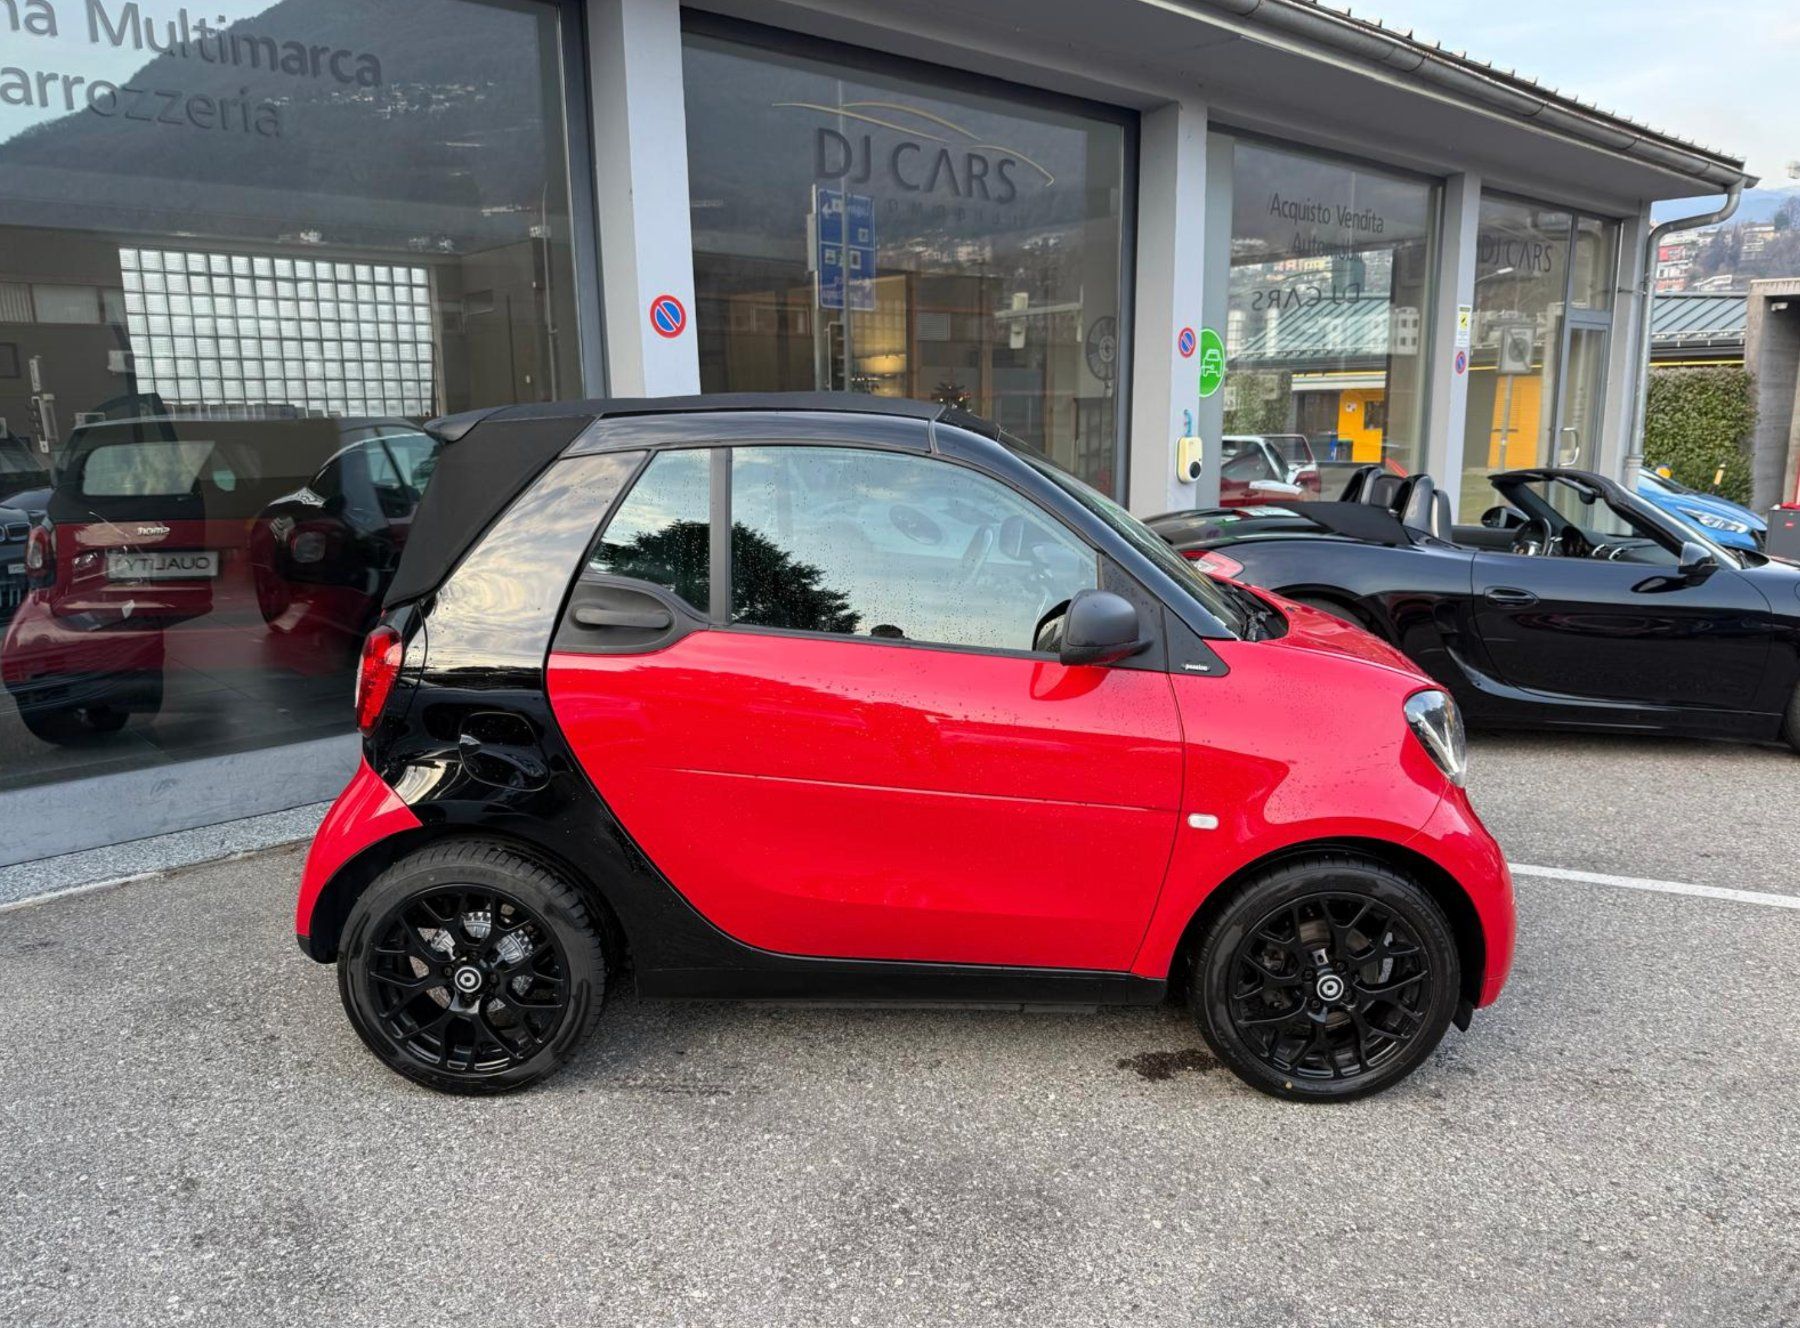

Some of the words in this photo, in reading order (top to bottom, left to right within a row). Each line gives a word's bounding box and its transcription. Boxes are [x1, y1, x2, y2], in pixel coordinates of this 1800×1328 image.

[86, 0, 382, 87] Multimarca
[816, 127, 872, 185] DJ
[890, 141, 1017, 204] CARS
[1269, 191, 1331, 225] Acquisto
[1336, 205, 1385, 234] Vendita
[1480, 235, 1500, 265] DJ
[1505, 240, 1554, 273] CARS
